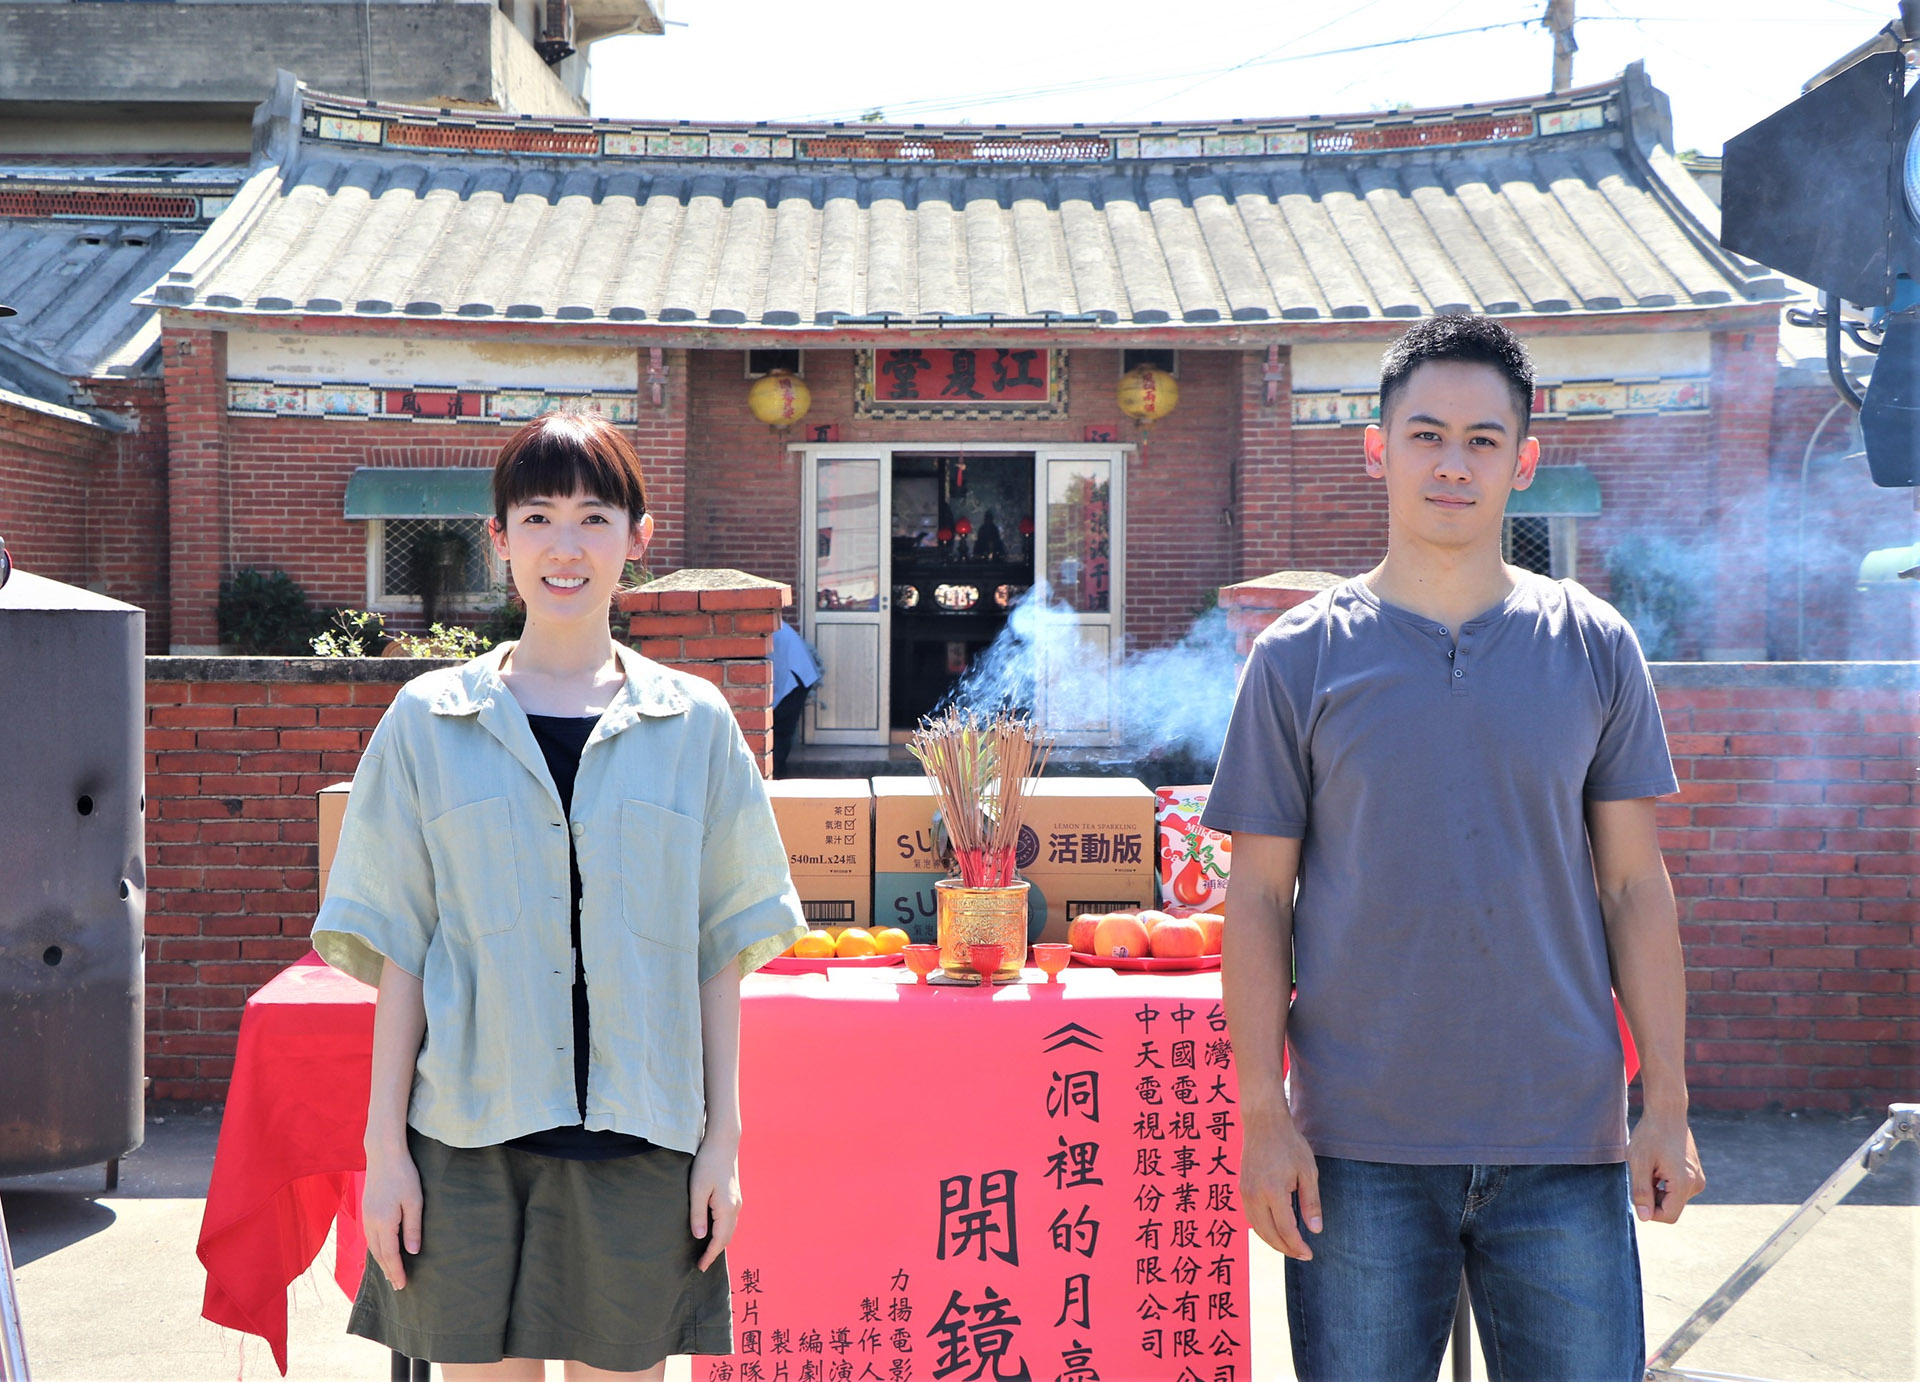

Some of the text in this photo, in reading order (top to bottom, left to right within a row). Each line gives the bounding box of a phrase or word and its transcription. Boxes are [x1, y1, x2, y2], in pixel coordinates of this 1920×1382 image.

[882, 348, 1044, 400] 江夏堂
[402, 393, 465, 416] 清風
[825, 820, 842, 830] 氣泡
[834, 806, 842, 815] 茶
[1184, 822, 1208, 838] Milk
[825, 835, 842, 845] 果汁
[1048, 833, 1142, 864] 活動版
[1161, 846, 1180, 863] Ca
[1133, 1003, 1168, 1359] 中天電視股份有限公司
[926, 1169, 1032, 1382] 開鏡
[739, 1268, 764, 1382] 製片團隊
[858, 1297, 885, 1382] 製作人
[888, 1267, 913, 1382] 力揚電影
[770, 1328, 794, 1382] 製片
[798, 1328, 823, 1382] 編劇
[829, 1326, 853, 1382] 導演
